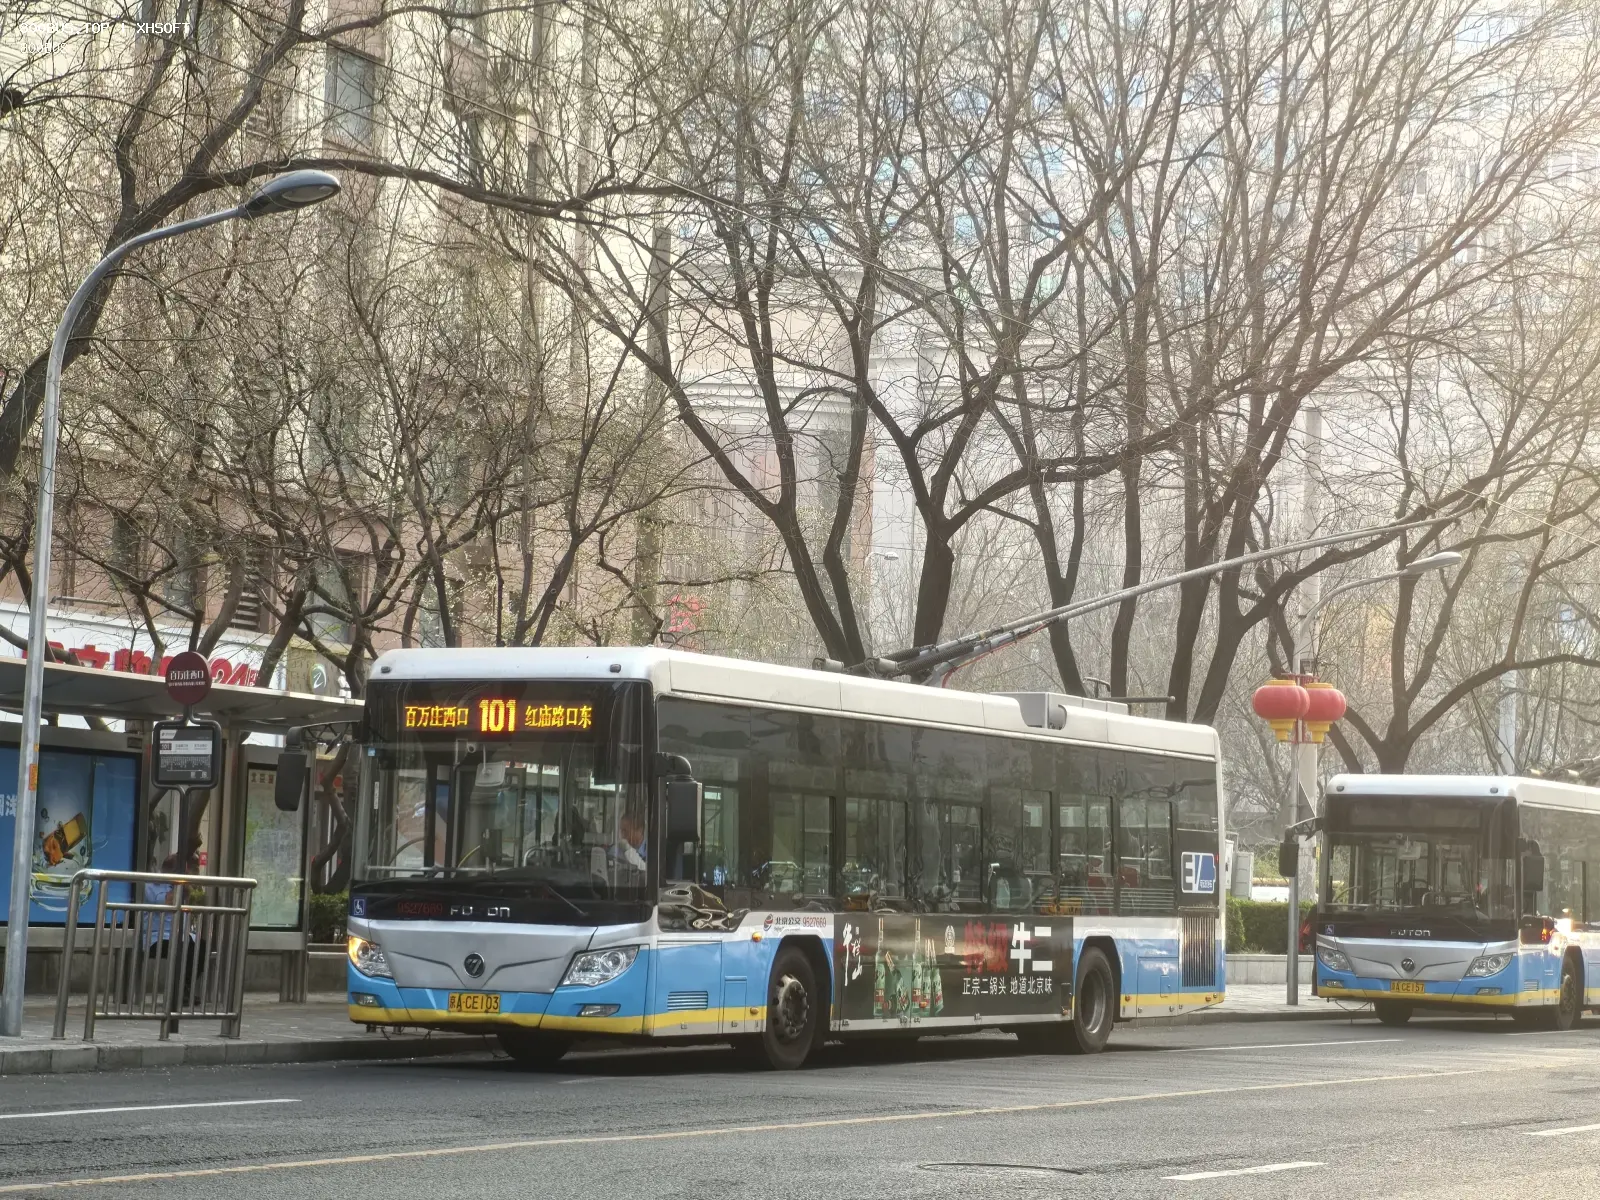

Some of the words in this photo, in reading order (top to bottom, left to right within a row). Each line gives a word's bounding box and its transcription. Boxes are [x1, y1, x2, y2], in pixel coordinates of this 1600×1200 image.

[404, 705, 469, 728] 百万庄西口
[479, 699, 517, 732] 101
[524, 704, 592, 729] 红庙路口东
[450, 905, 511, 918] FOON
[775, 916, 800, 926] 北京公交
[962, 976, 1006, 995] 正宗二锅头
[1009, 976, 1053, 995] 地道北京味
